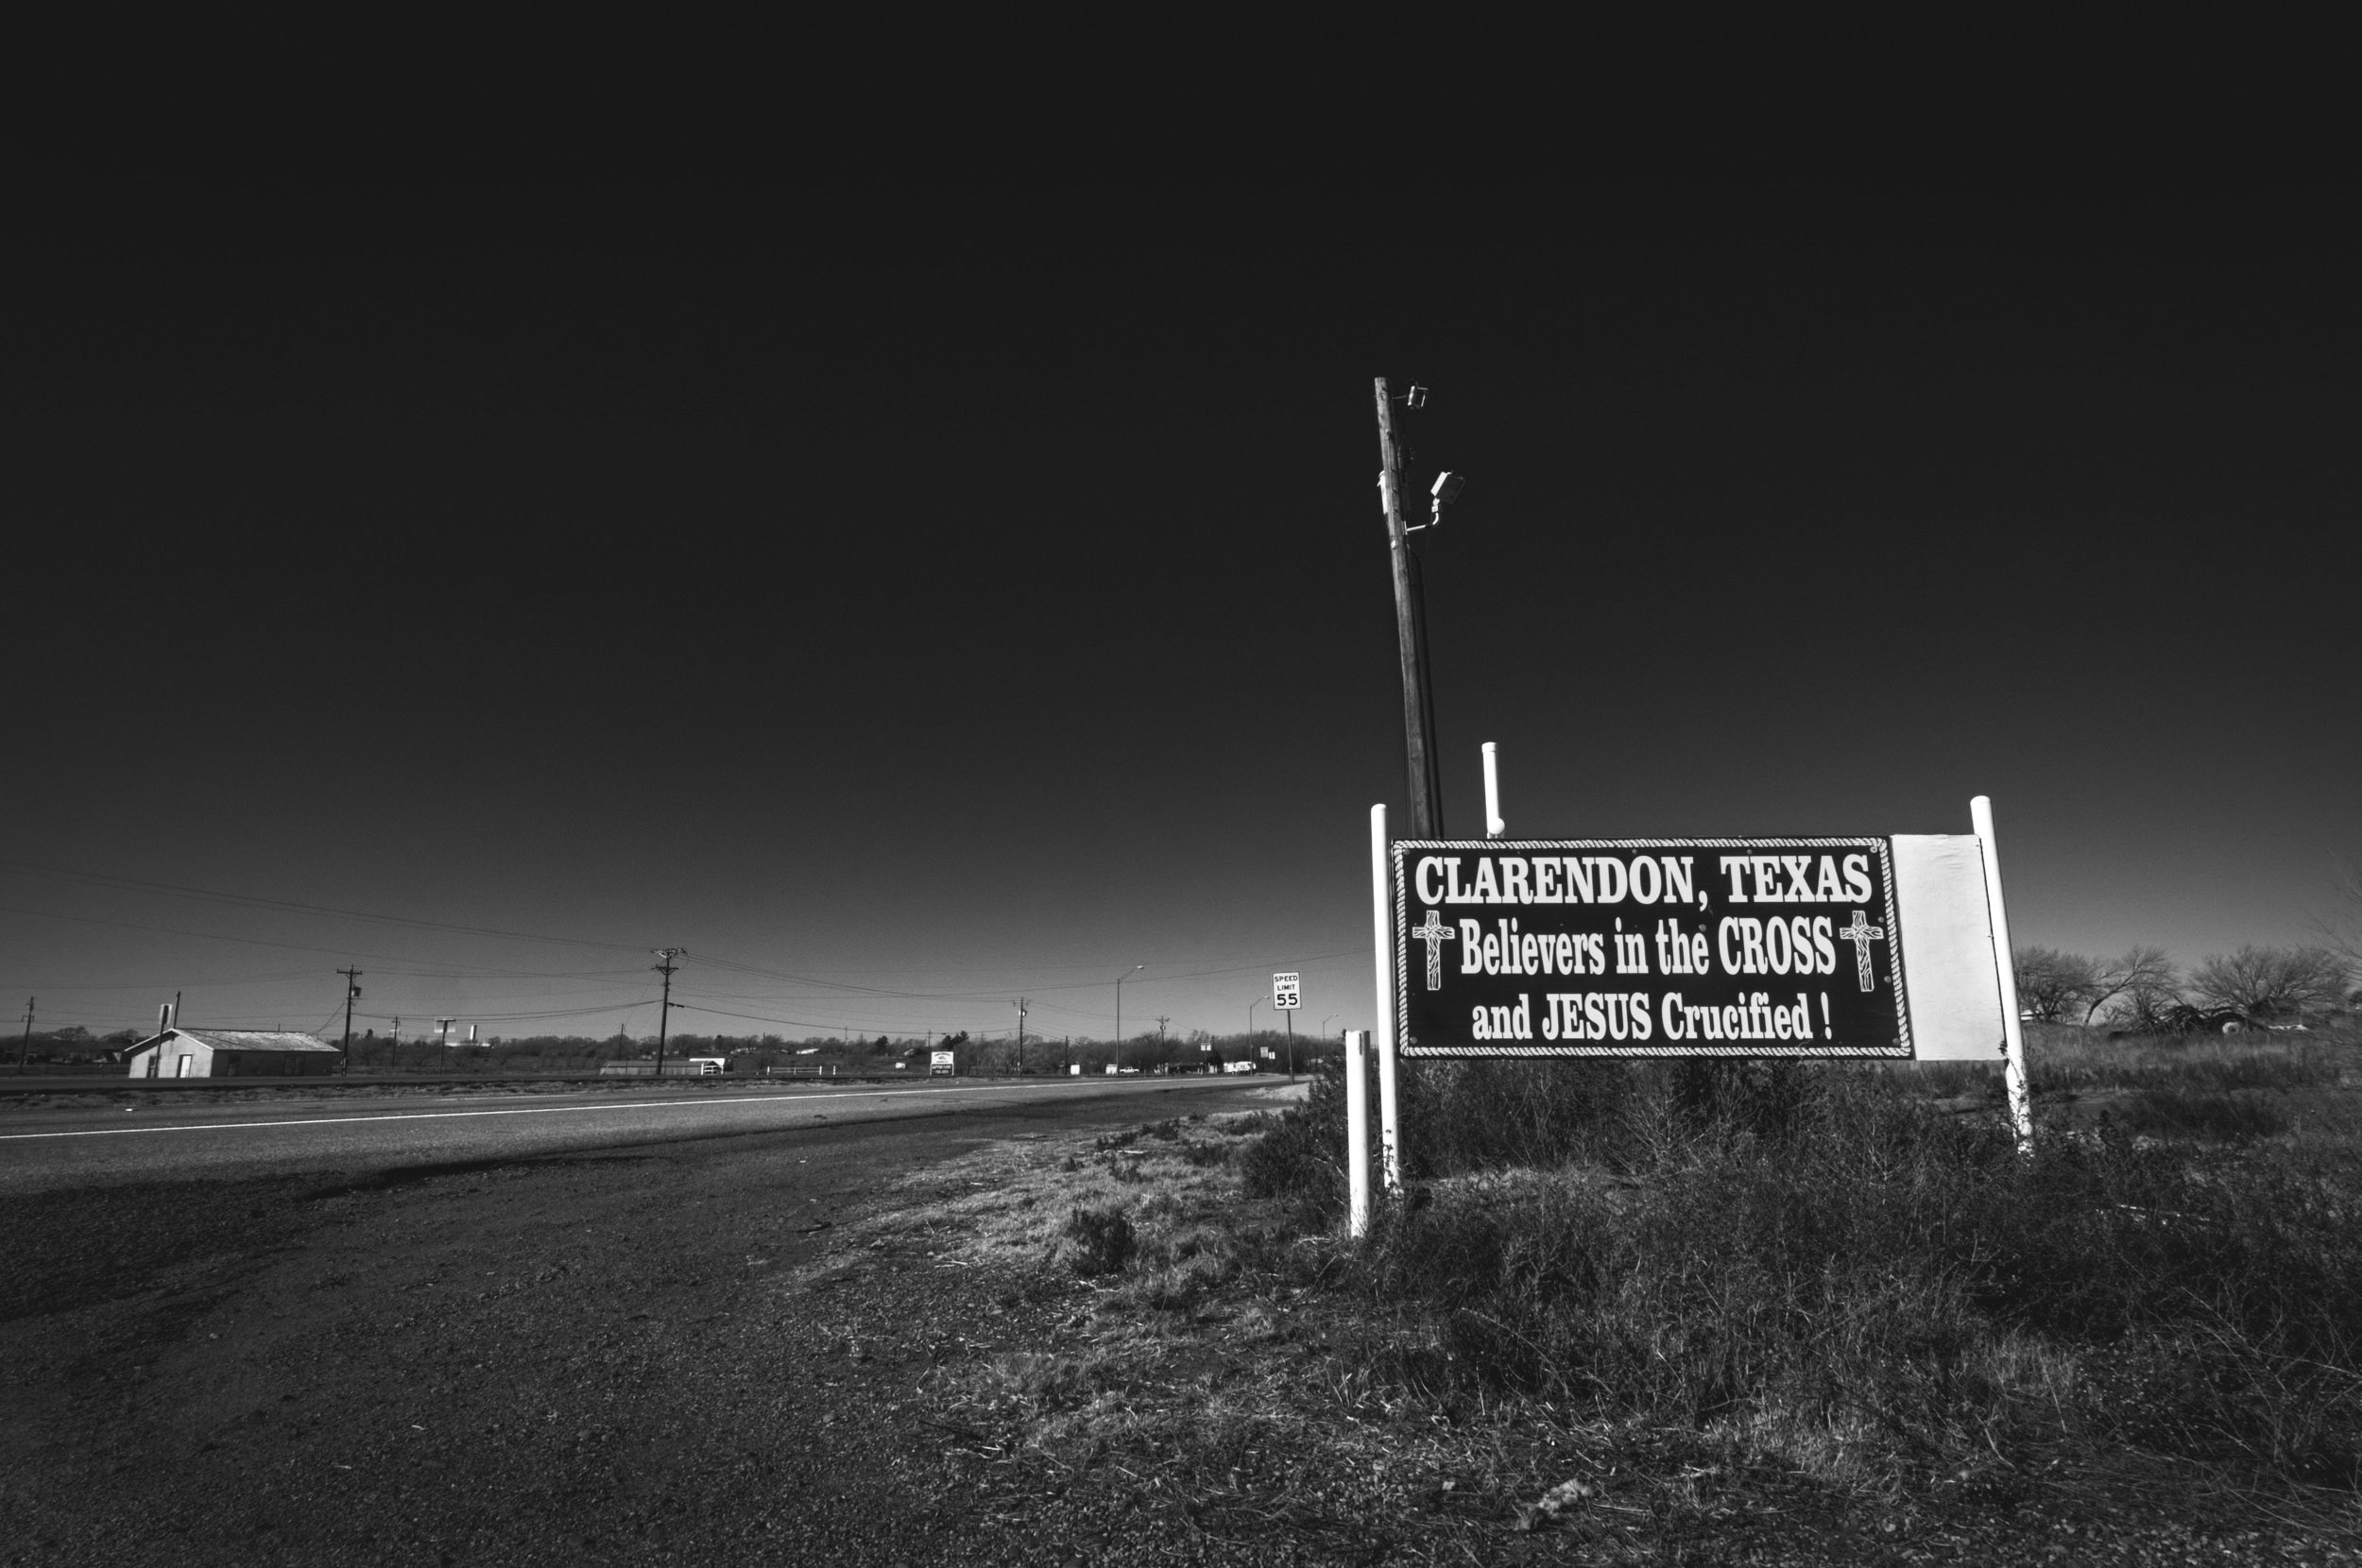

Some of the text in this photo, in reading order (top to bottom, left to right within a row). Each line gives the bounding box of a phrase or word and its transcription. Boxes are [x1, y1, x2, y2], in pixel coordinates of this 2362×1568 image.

[1415, 853, 1873, 912] CLARENDON, TEXAS
[1459, 915, 1837, 976] Believers in the CROSS
[1276, 993, 1298, 1006] 55
[1472, 993, 1533, 1041] and
[1541, 992, 1652, 1041] JESUS
[1661, 991, 1814, 1041] Crucified
